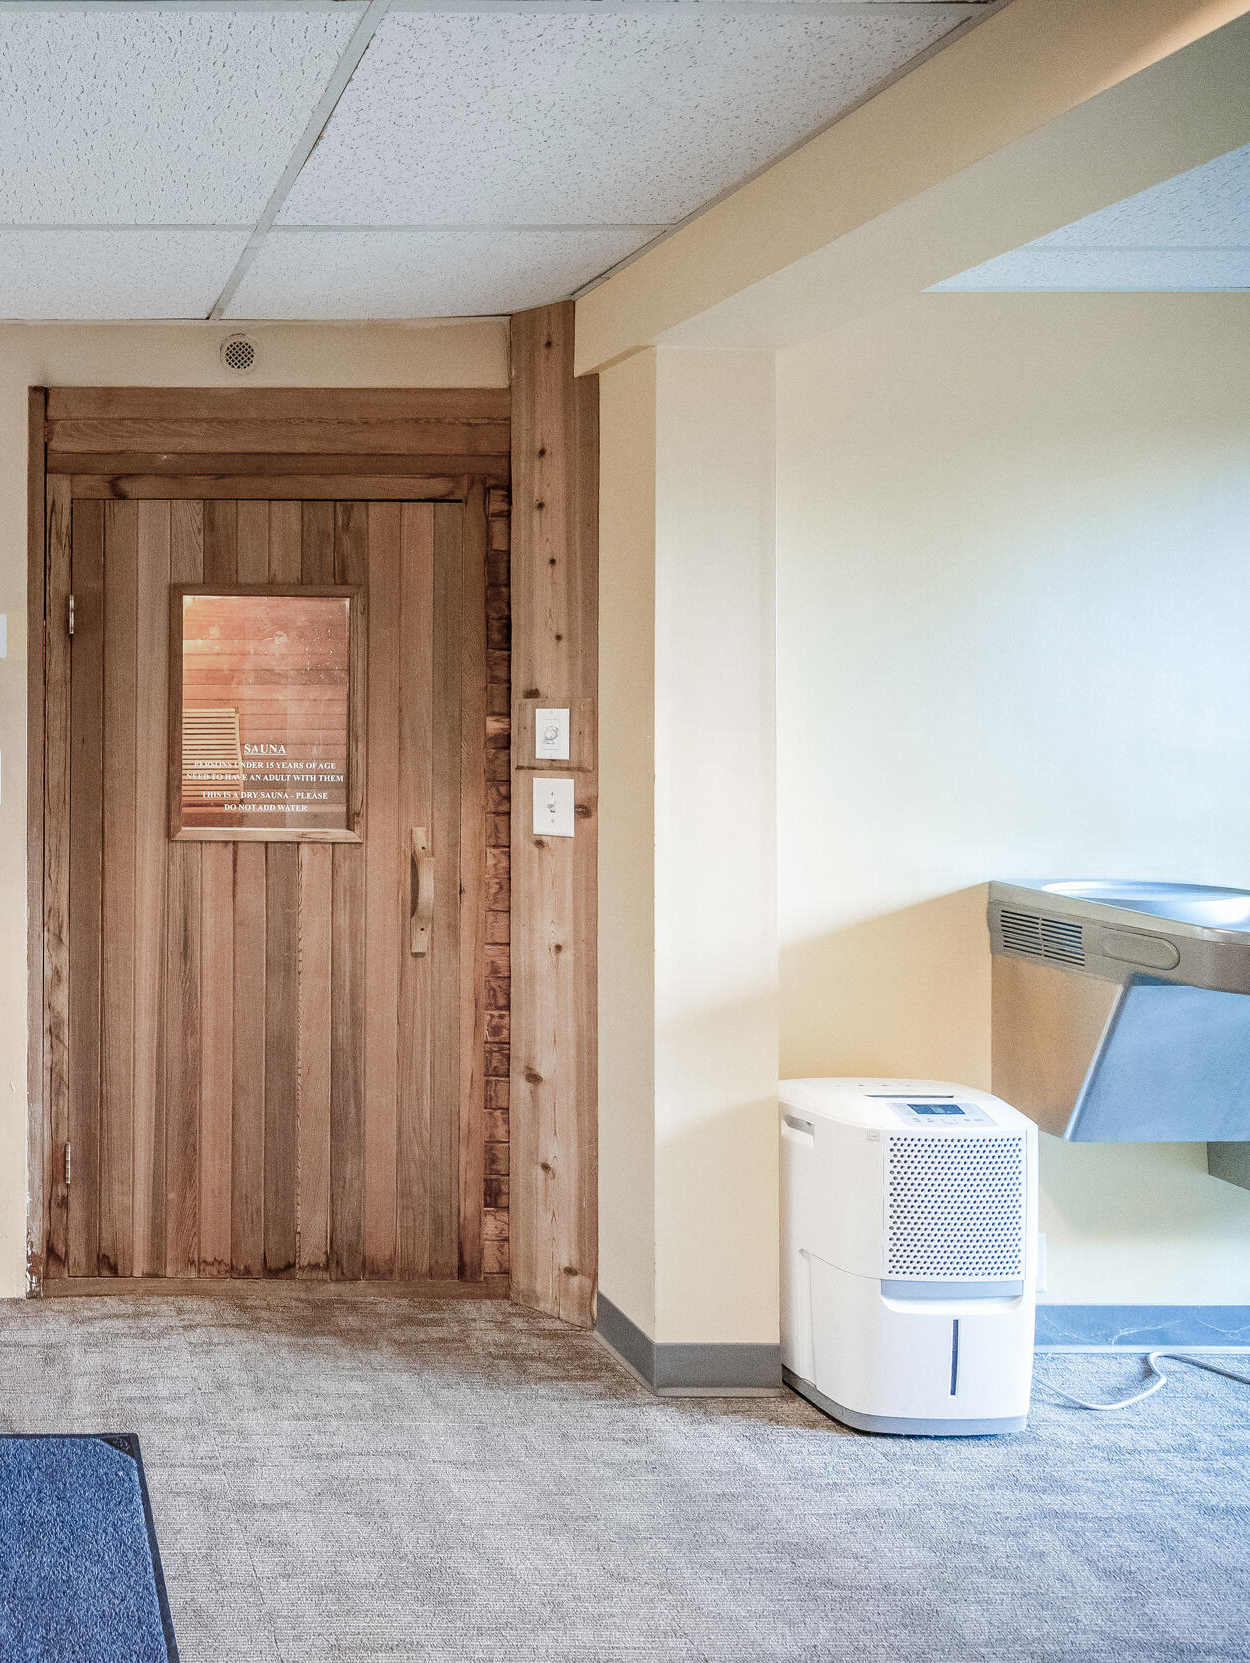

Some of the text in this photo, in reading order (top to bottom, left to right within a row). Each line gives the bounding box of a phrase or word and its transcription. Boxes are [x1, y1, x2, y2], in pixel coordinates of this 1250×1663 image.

[243, 743, 287, 754] SAUNA
[266, 761, 275, 769] 15
[276, 761, 304, 769] YEARS
[318, 762, 337, 770] AGE
[225, 773, 248, 781] HAVE
[263, 774, 291, 782] ADULT
[293, 774, 317, 782] WITH
[318, 774, 344, 782] THEM
[241, 791, 258, 799] DRY
[260, 791, 289, 799] SAUNA
[278, 804, 308, 812] WATER
